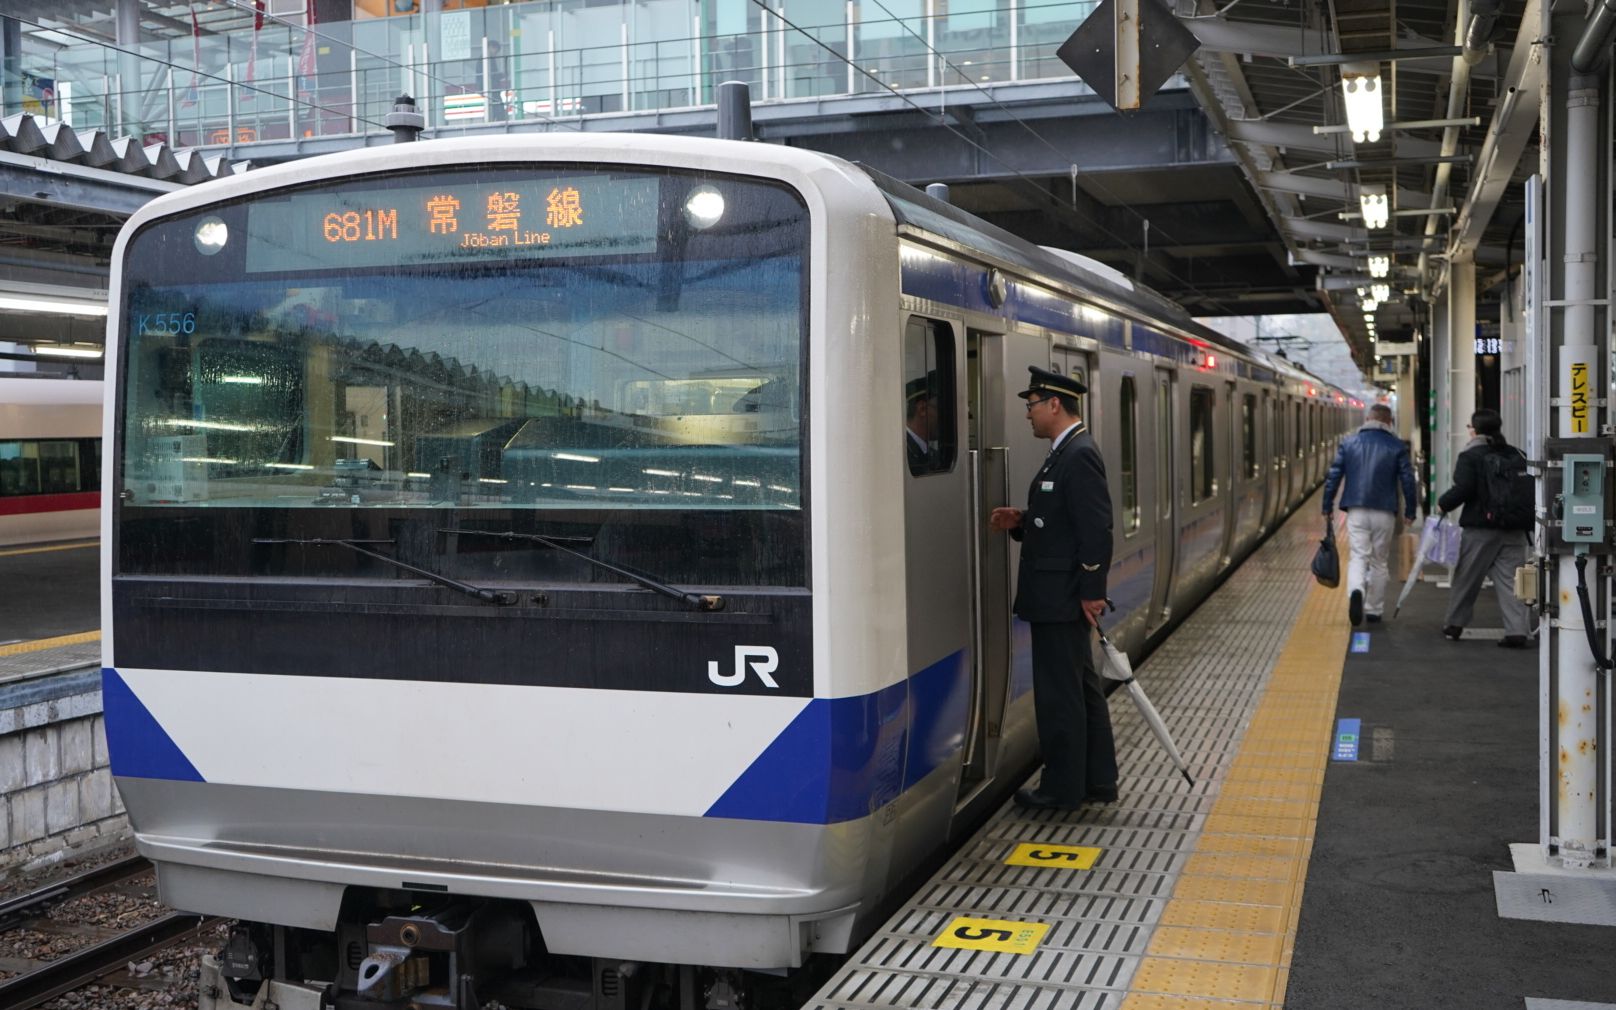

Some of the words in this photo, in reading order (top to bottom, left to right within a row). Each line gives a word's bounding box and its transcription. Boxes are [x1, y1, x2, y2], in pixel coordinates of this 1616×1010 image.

[426, 186, 584, 234] 常磐線
[323, 209, 398, 243] 681M
[460, 231, 508, 248] Jōban
[514, 229, 551, 245] Line
[139, 312, 195, 335] K556
[708, 645, 779, 688] JR
[1029, 850, 1079, 861] 5
[954, 926, 1013, 942] 5
